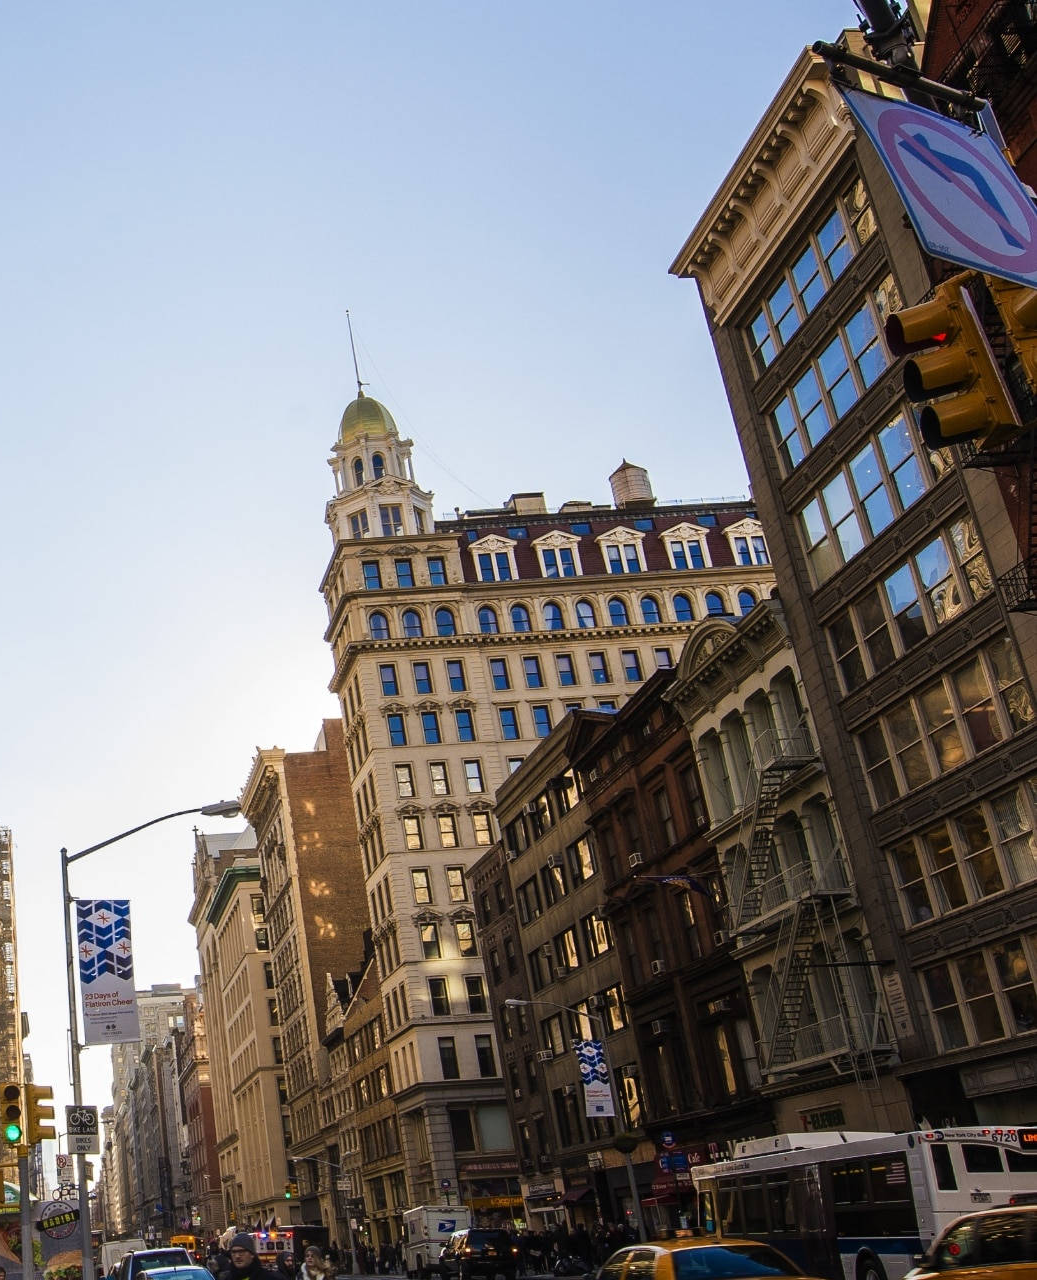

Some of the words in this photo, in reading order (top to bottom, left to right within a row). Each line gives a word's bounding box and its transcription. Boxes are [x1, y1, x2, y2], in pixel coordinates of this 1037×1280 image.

[94, 992, 112, 1000] Days
[85, 1000, 111, 1008] Flatiron
[112, 999, 133, 1007] Cheer
[992, 1132, 1017, 1142] 6720
[76, 1144, 91, 1152] ONLY
